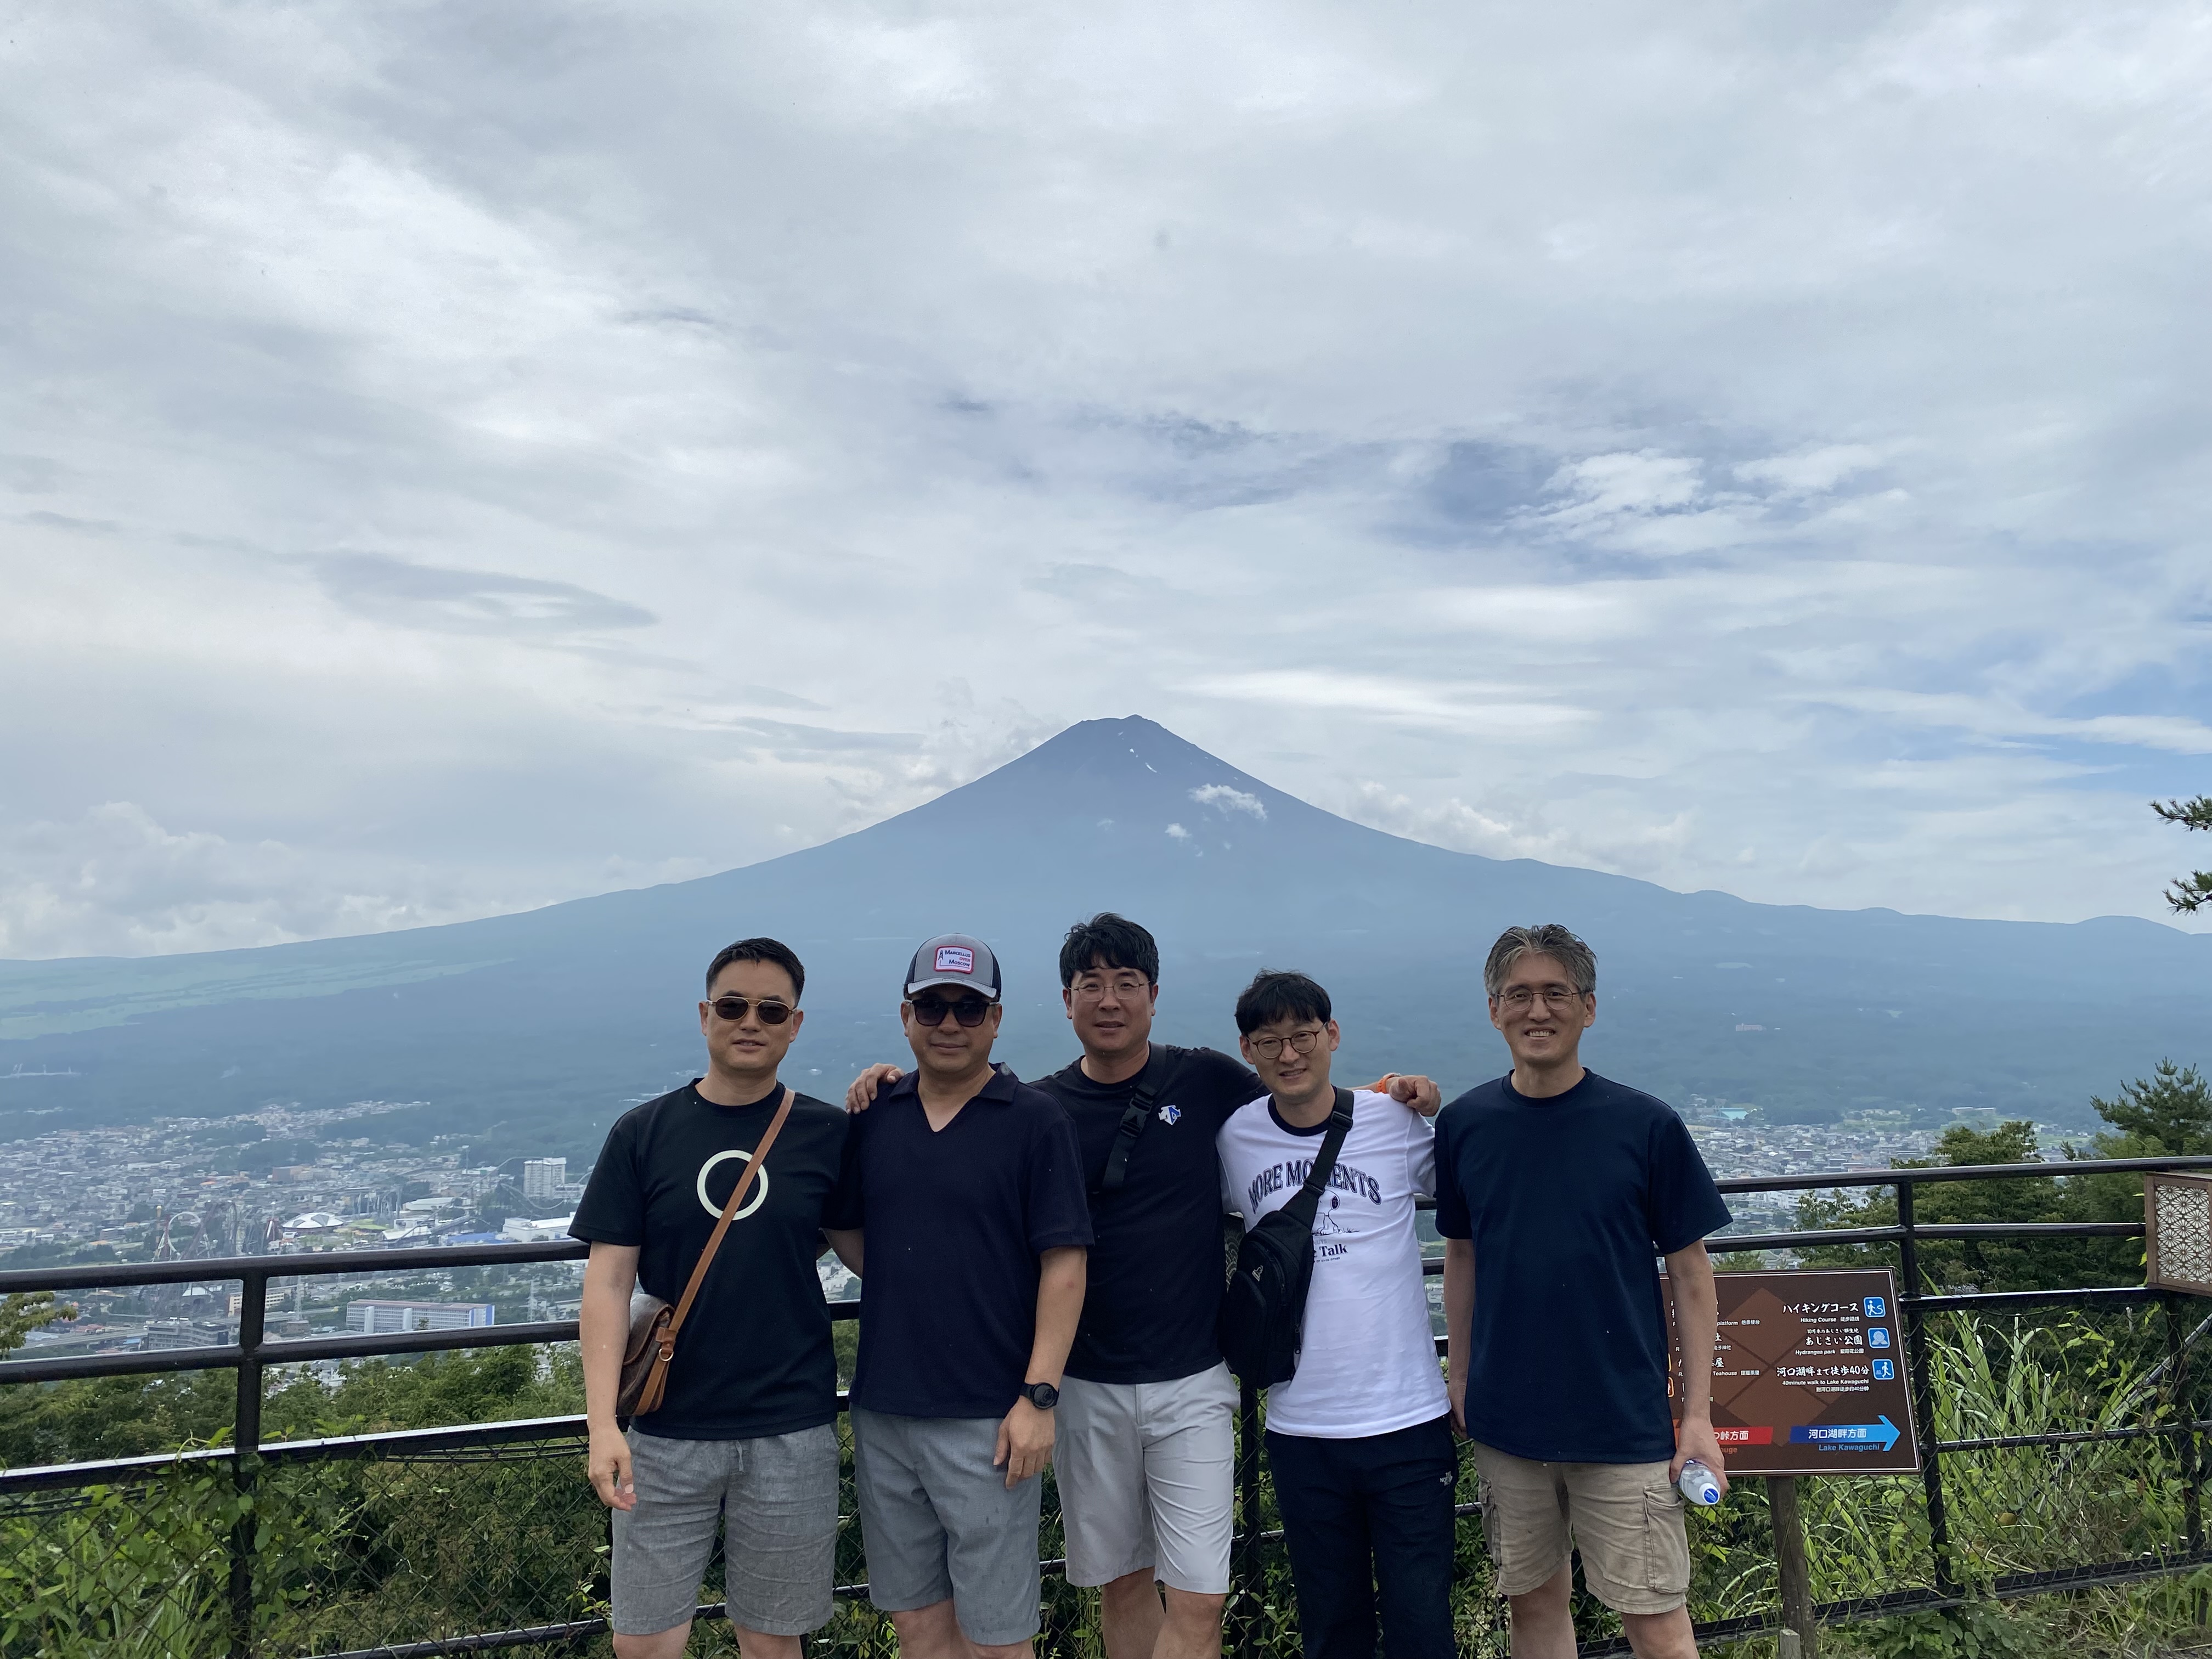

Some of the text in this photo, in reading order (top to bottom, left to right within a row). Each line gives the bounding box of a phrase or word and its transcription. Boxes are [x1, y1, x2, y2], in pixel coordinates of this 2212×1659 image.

[1248, 1159, 1381, 1215] MORE MOENTS
[1319, 1243, 1348, 1257] Talk
[1783, 1303, 1859, 1313] ハイキングコース
[1805, 1335, 1863, 1345] あじさい公園
[1808, 1428, 1867, 1439] 河口湖畔方面
[1838, 1443, 1880, 1452] Kawaguchi
